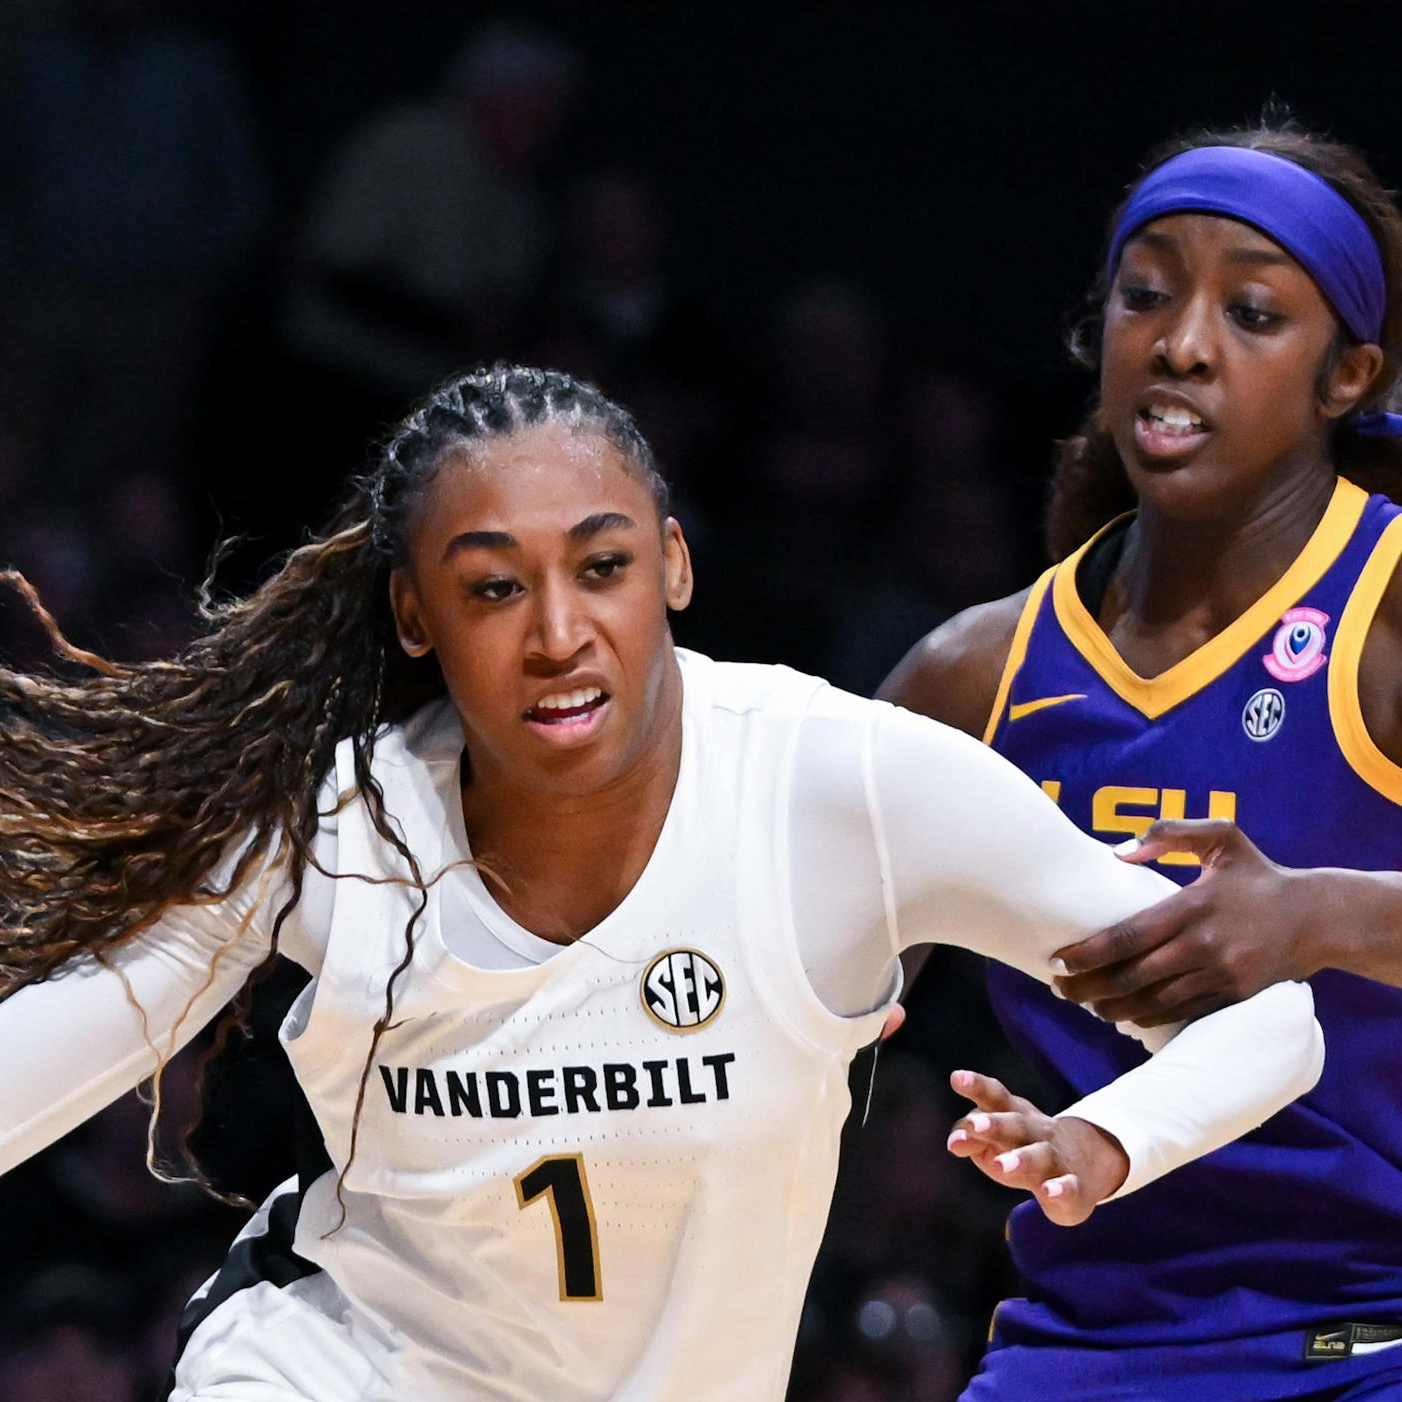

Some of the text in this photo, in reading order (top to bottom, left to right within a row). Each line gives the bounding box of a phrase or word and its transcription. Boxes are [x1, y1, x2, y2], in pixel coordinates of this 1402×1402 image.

[1246, 691, 1285, 740] SEC
[1041, 780, 1237, 866] SU
[645, 951, 723, 1029] SEC
[378, 1052, 736, 1120] VANDERBILT
[513, 1152, 604, 1302] 1
